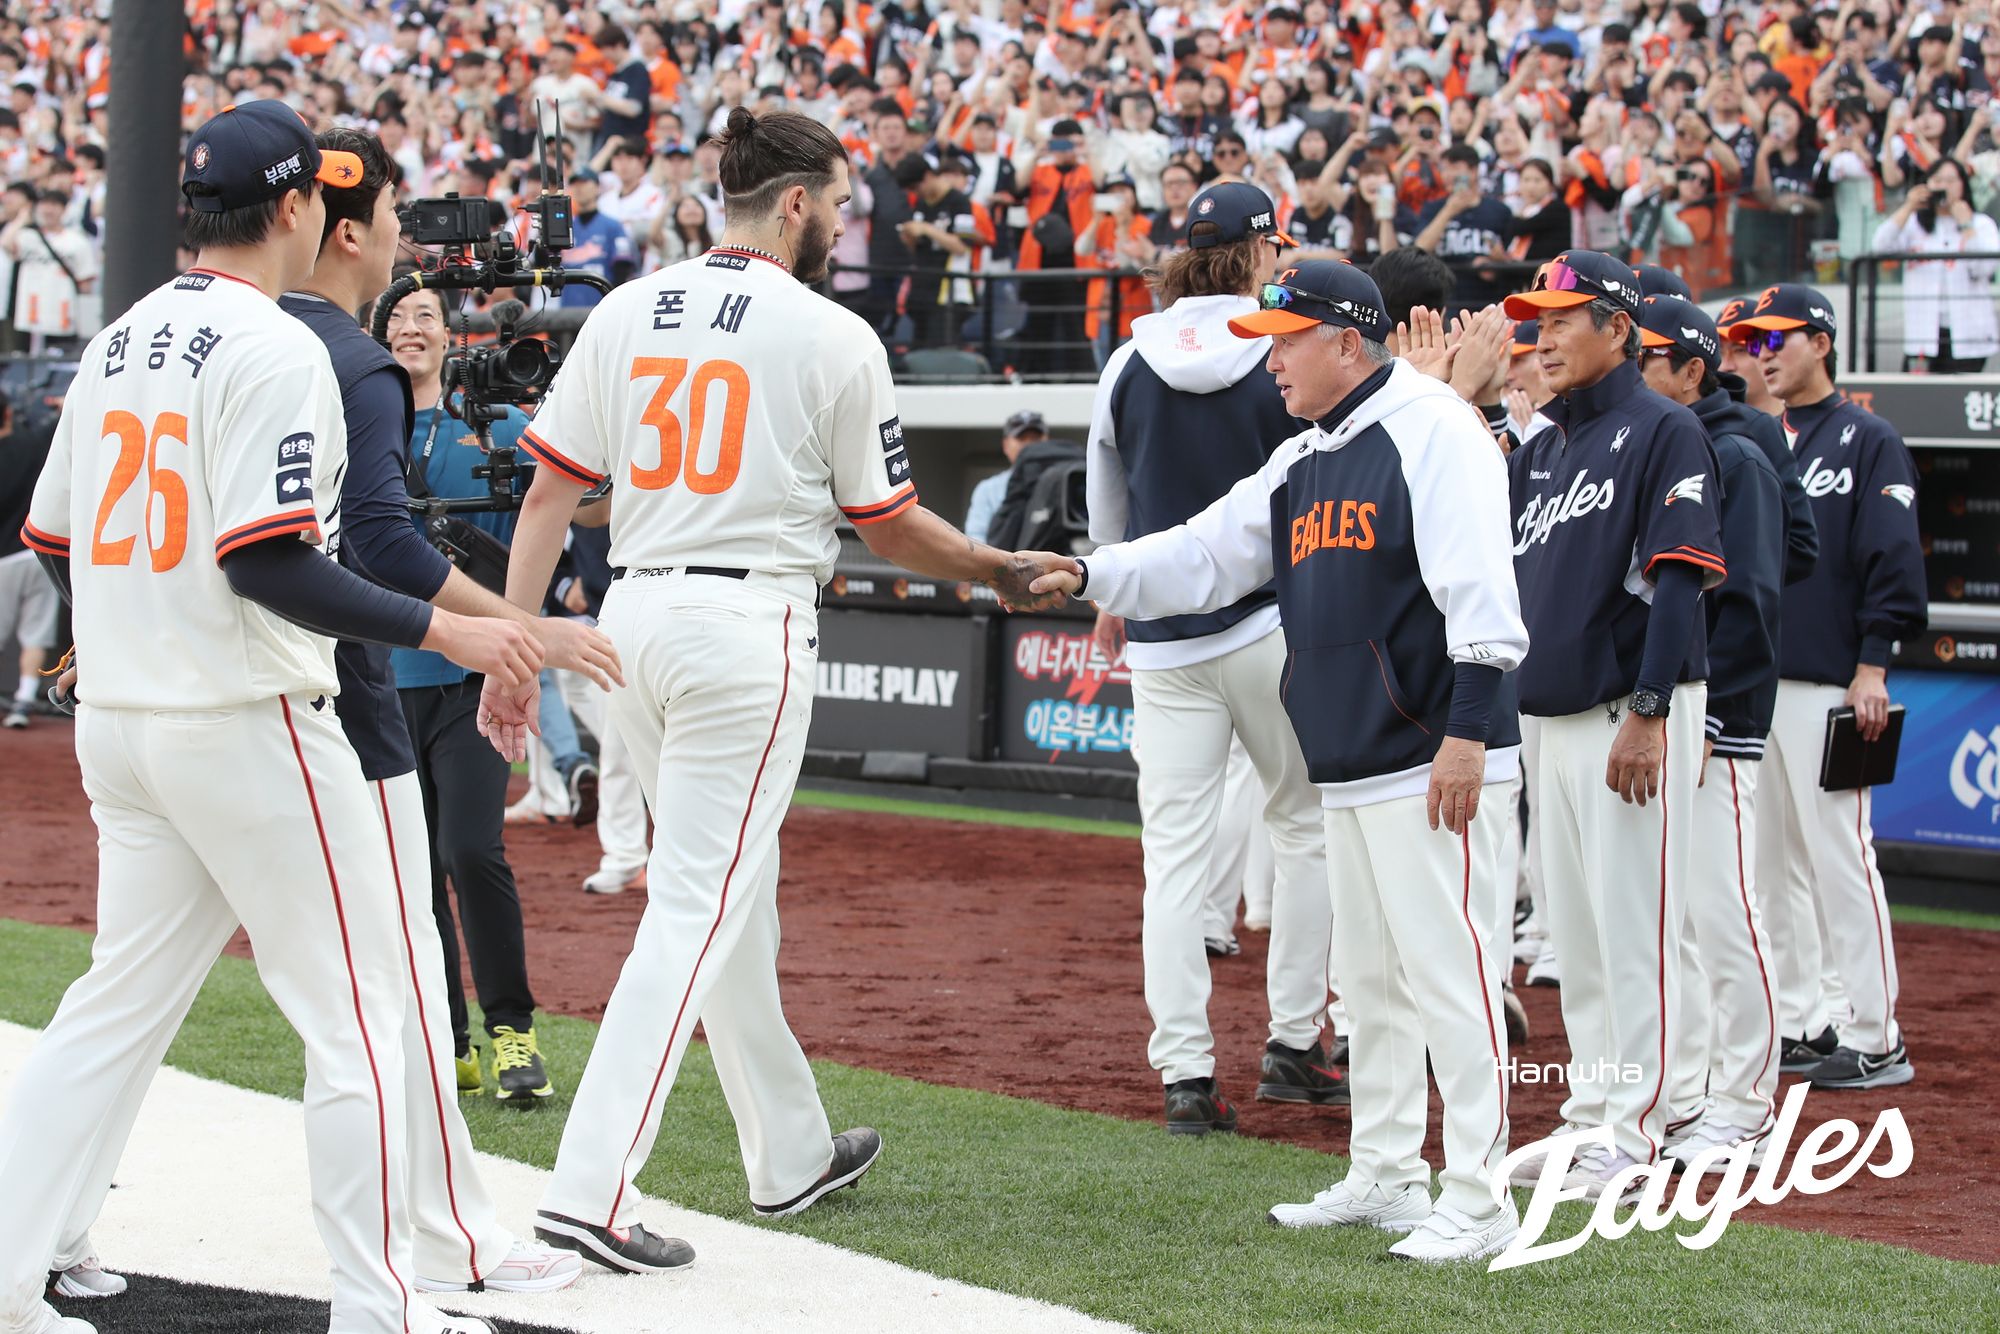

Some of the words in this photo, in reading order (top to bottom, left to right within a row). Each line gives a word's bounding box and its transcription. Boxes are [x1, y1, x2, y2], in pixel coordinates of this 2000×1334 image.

[264, 155, 302, 185] 부루펜
[1353, 311, 1377, 325] PLUS
[1354, 303, 1379, 318] LIFE
[630, 357, 750, 494] 30
[1964, 391, 2000, 431] 한
[92, 410, 188, 572] 26
[1292, 500, 1376, 567] EAGLES
[632, 567, 673, 578] SPYDER
[882, 666, 959, 707] PLAY
